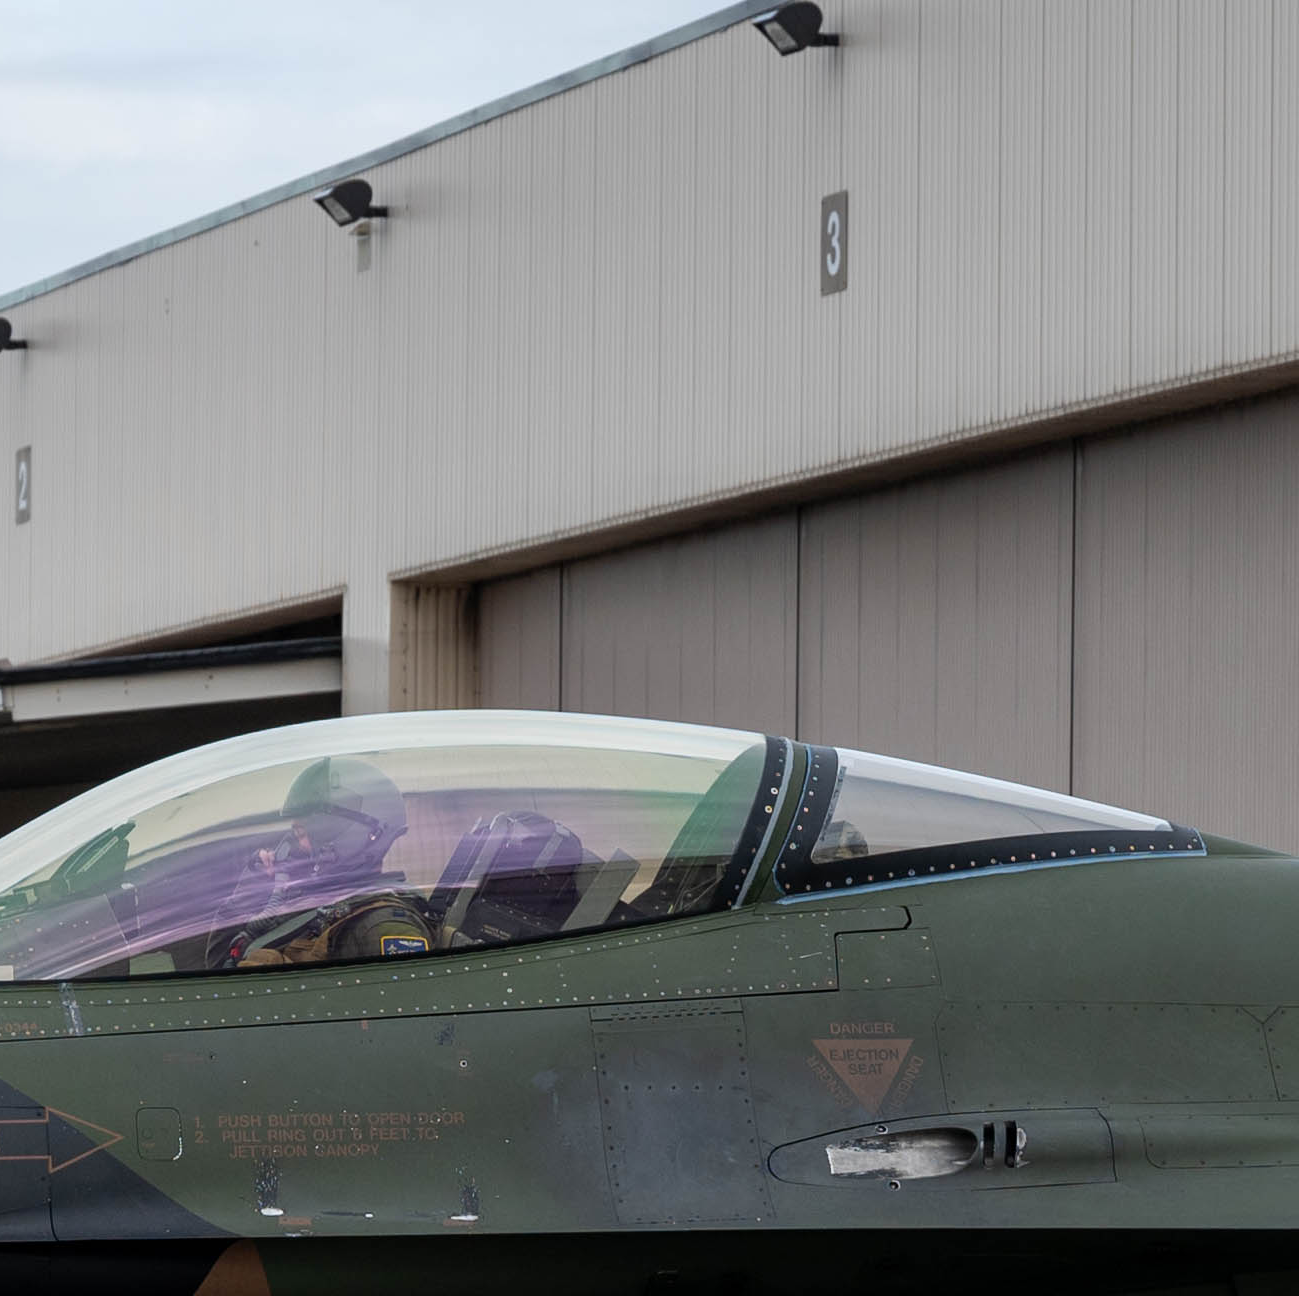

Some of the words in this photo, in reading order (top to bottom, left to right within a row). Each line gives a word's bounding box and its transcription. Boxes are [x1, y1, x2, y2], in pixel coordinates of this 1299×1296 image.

[827, 210, 841, 276] 3
[19, 461, 27, 509] 2
[829, 1023, 896, 1034] DANGER
[830, 1048, 899, 1061] EJECTION
[849, 1063, 884, 1076] SEAT
[218, 1115, 261, 1128] PUSH
[268, 1113, 332, 1127] BUTTON
[340, 1113, 360, 1126] TO
[368, 1112, 411, 1126] OPEN
[418, 1111, 465, 1125] DOOR
[222, 1130, 260, 1143] PULL
[267, 1129, 306, 1142] RING
[313, 1128, 345, 1141] OUT
[370, 1128, 409, 1141] FEET
[315, 1143, 379, 1157] CANOPY
